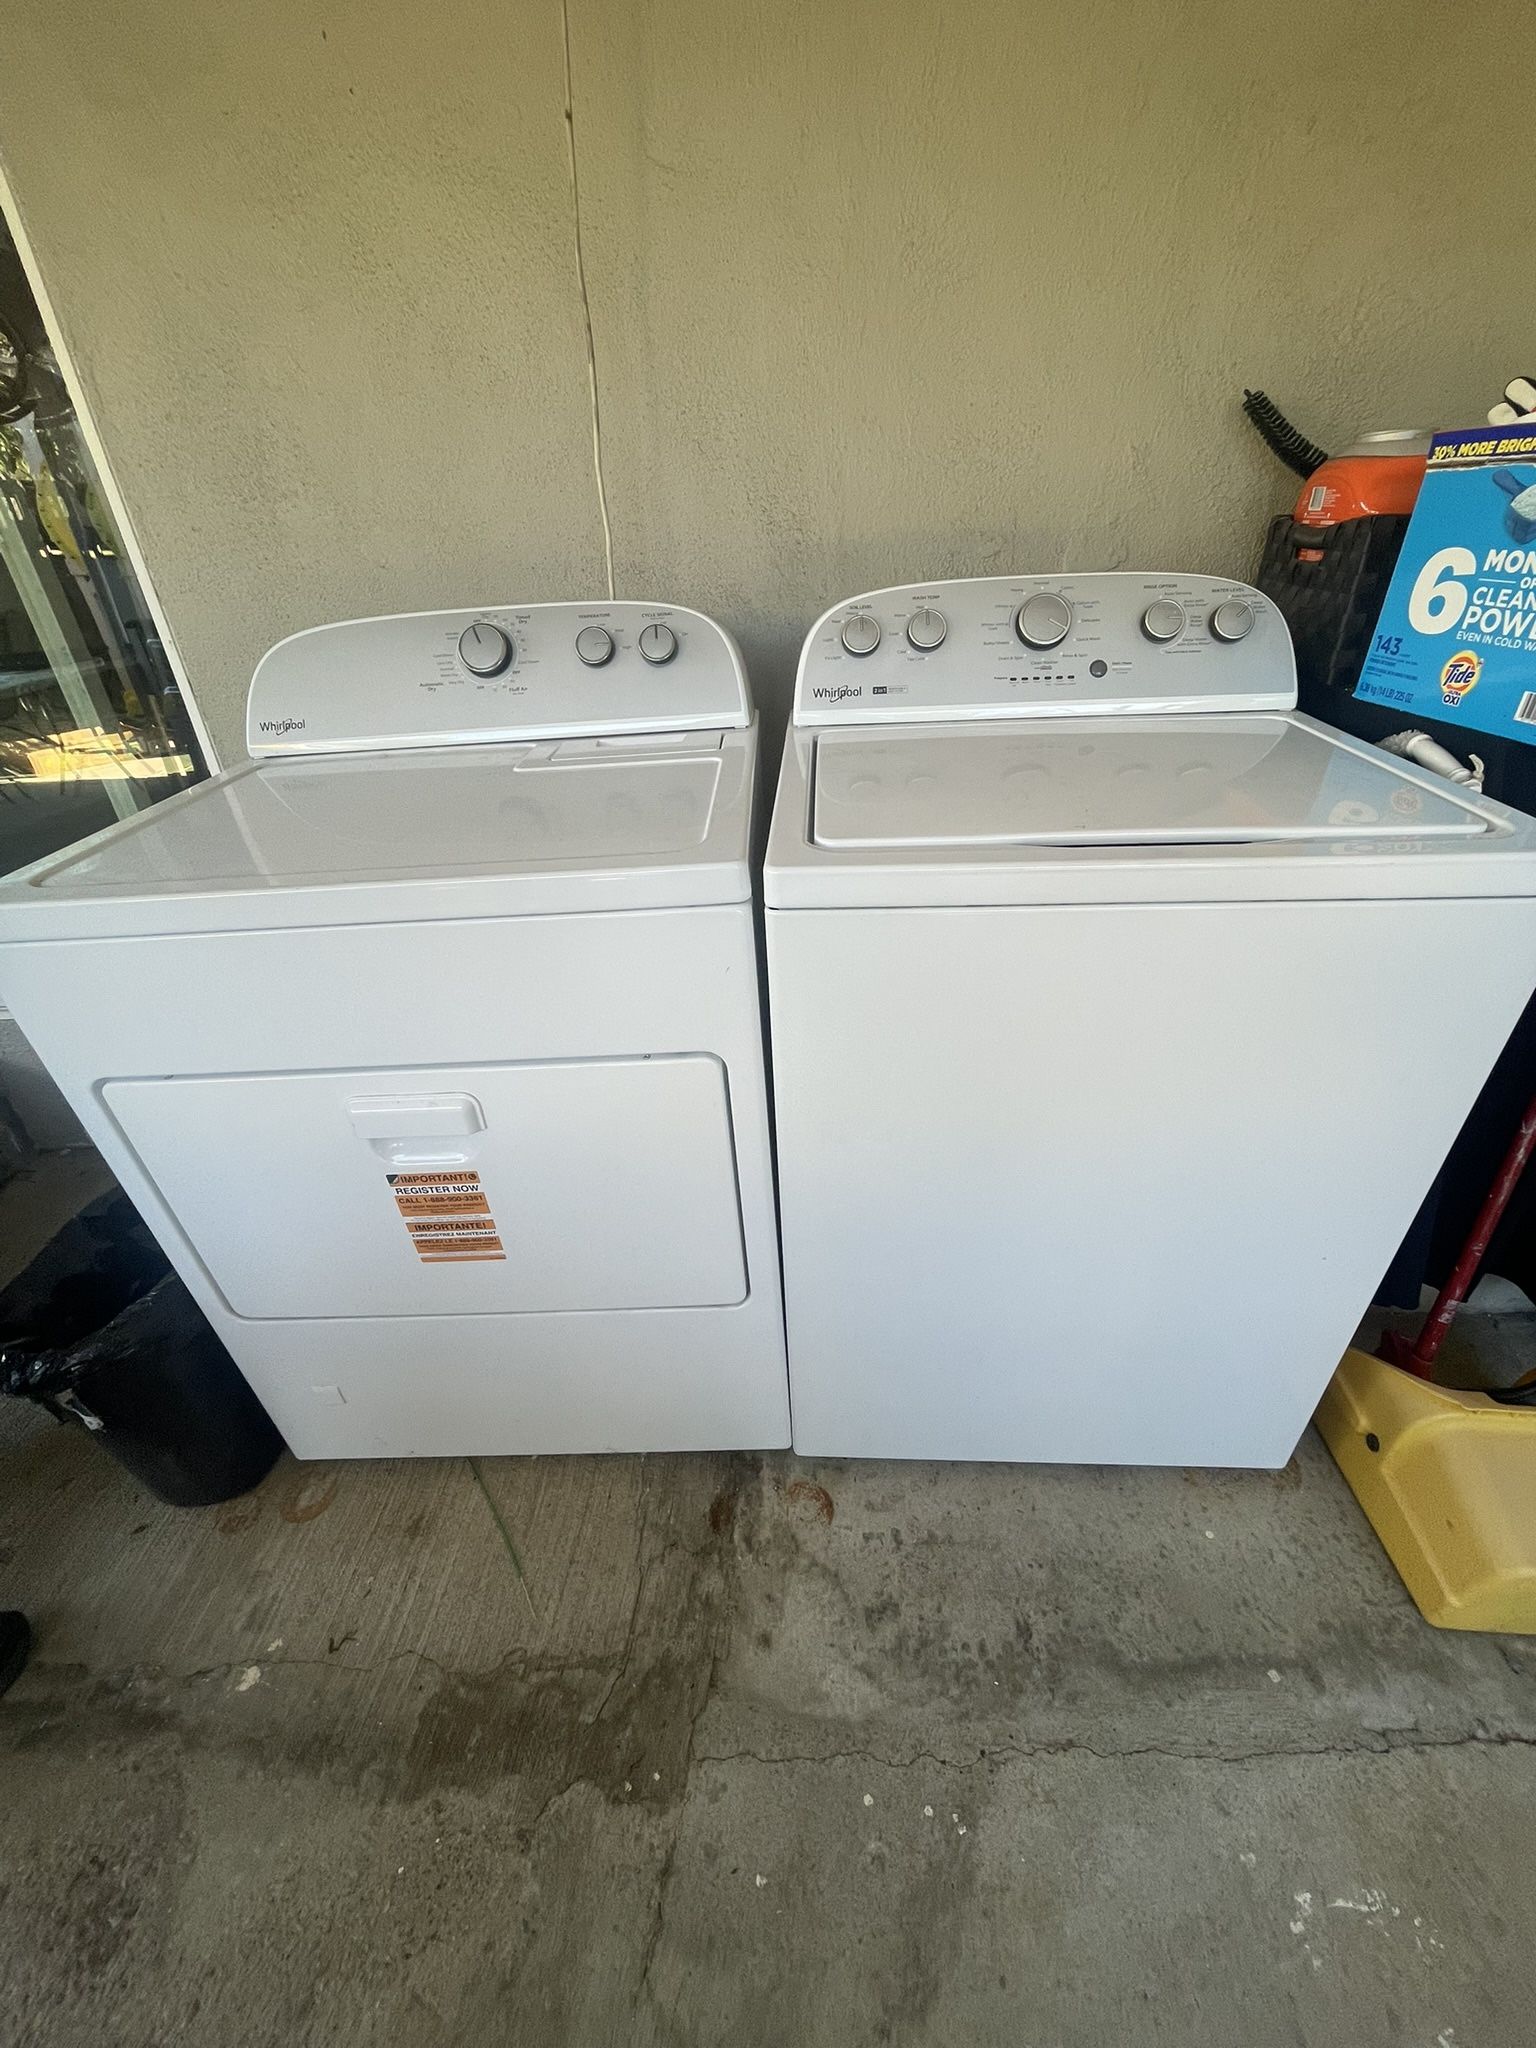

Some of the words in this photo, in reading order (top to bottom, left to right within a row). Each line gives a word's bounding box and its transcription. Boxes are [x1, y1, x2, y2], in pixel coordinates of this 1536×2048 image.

[1457, 441, 1498, 456] MORE
[1408, 547, 1477, 635] 6
[1375, 634, 1403, 656] 143
[1456, 631, 1481, 643] EVEN
[1482, 635, 1492, 644] IN
[1494, 636, 1522, 648] COLD
[1443, 664, 1475, 687] Tide
[812, 685, 862, 703] Whirlpool
[1443, 694, 1460, 706] OXI
[259, 718, 306, 736] Whirlpool
[400, 1174, 468, 1183] IMPORTANT!
[395, 1186, 450, 1195] REGISTER
[398, 1196, 421, 1204] CALL
[414, 1222, 486, 1231] IMPORTANTE!
